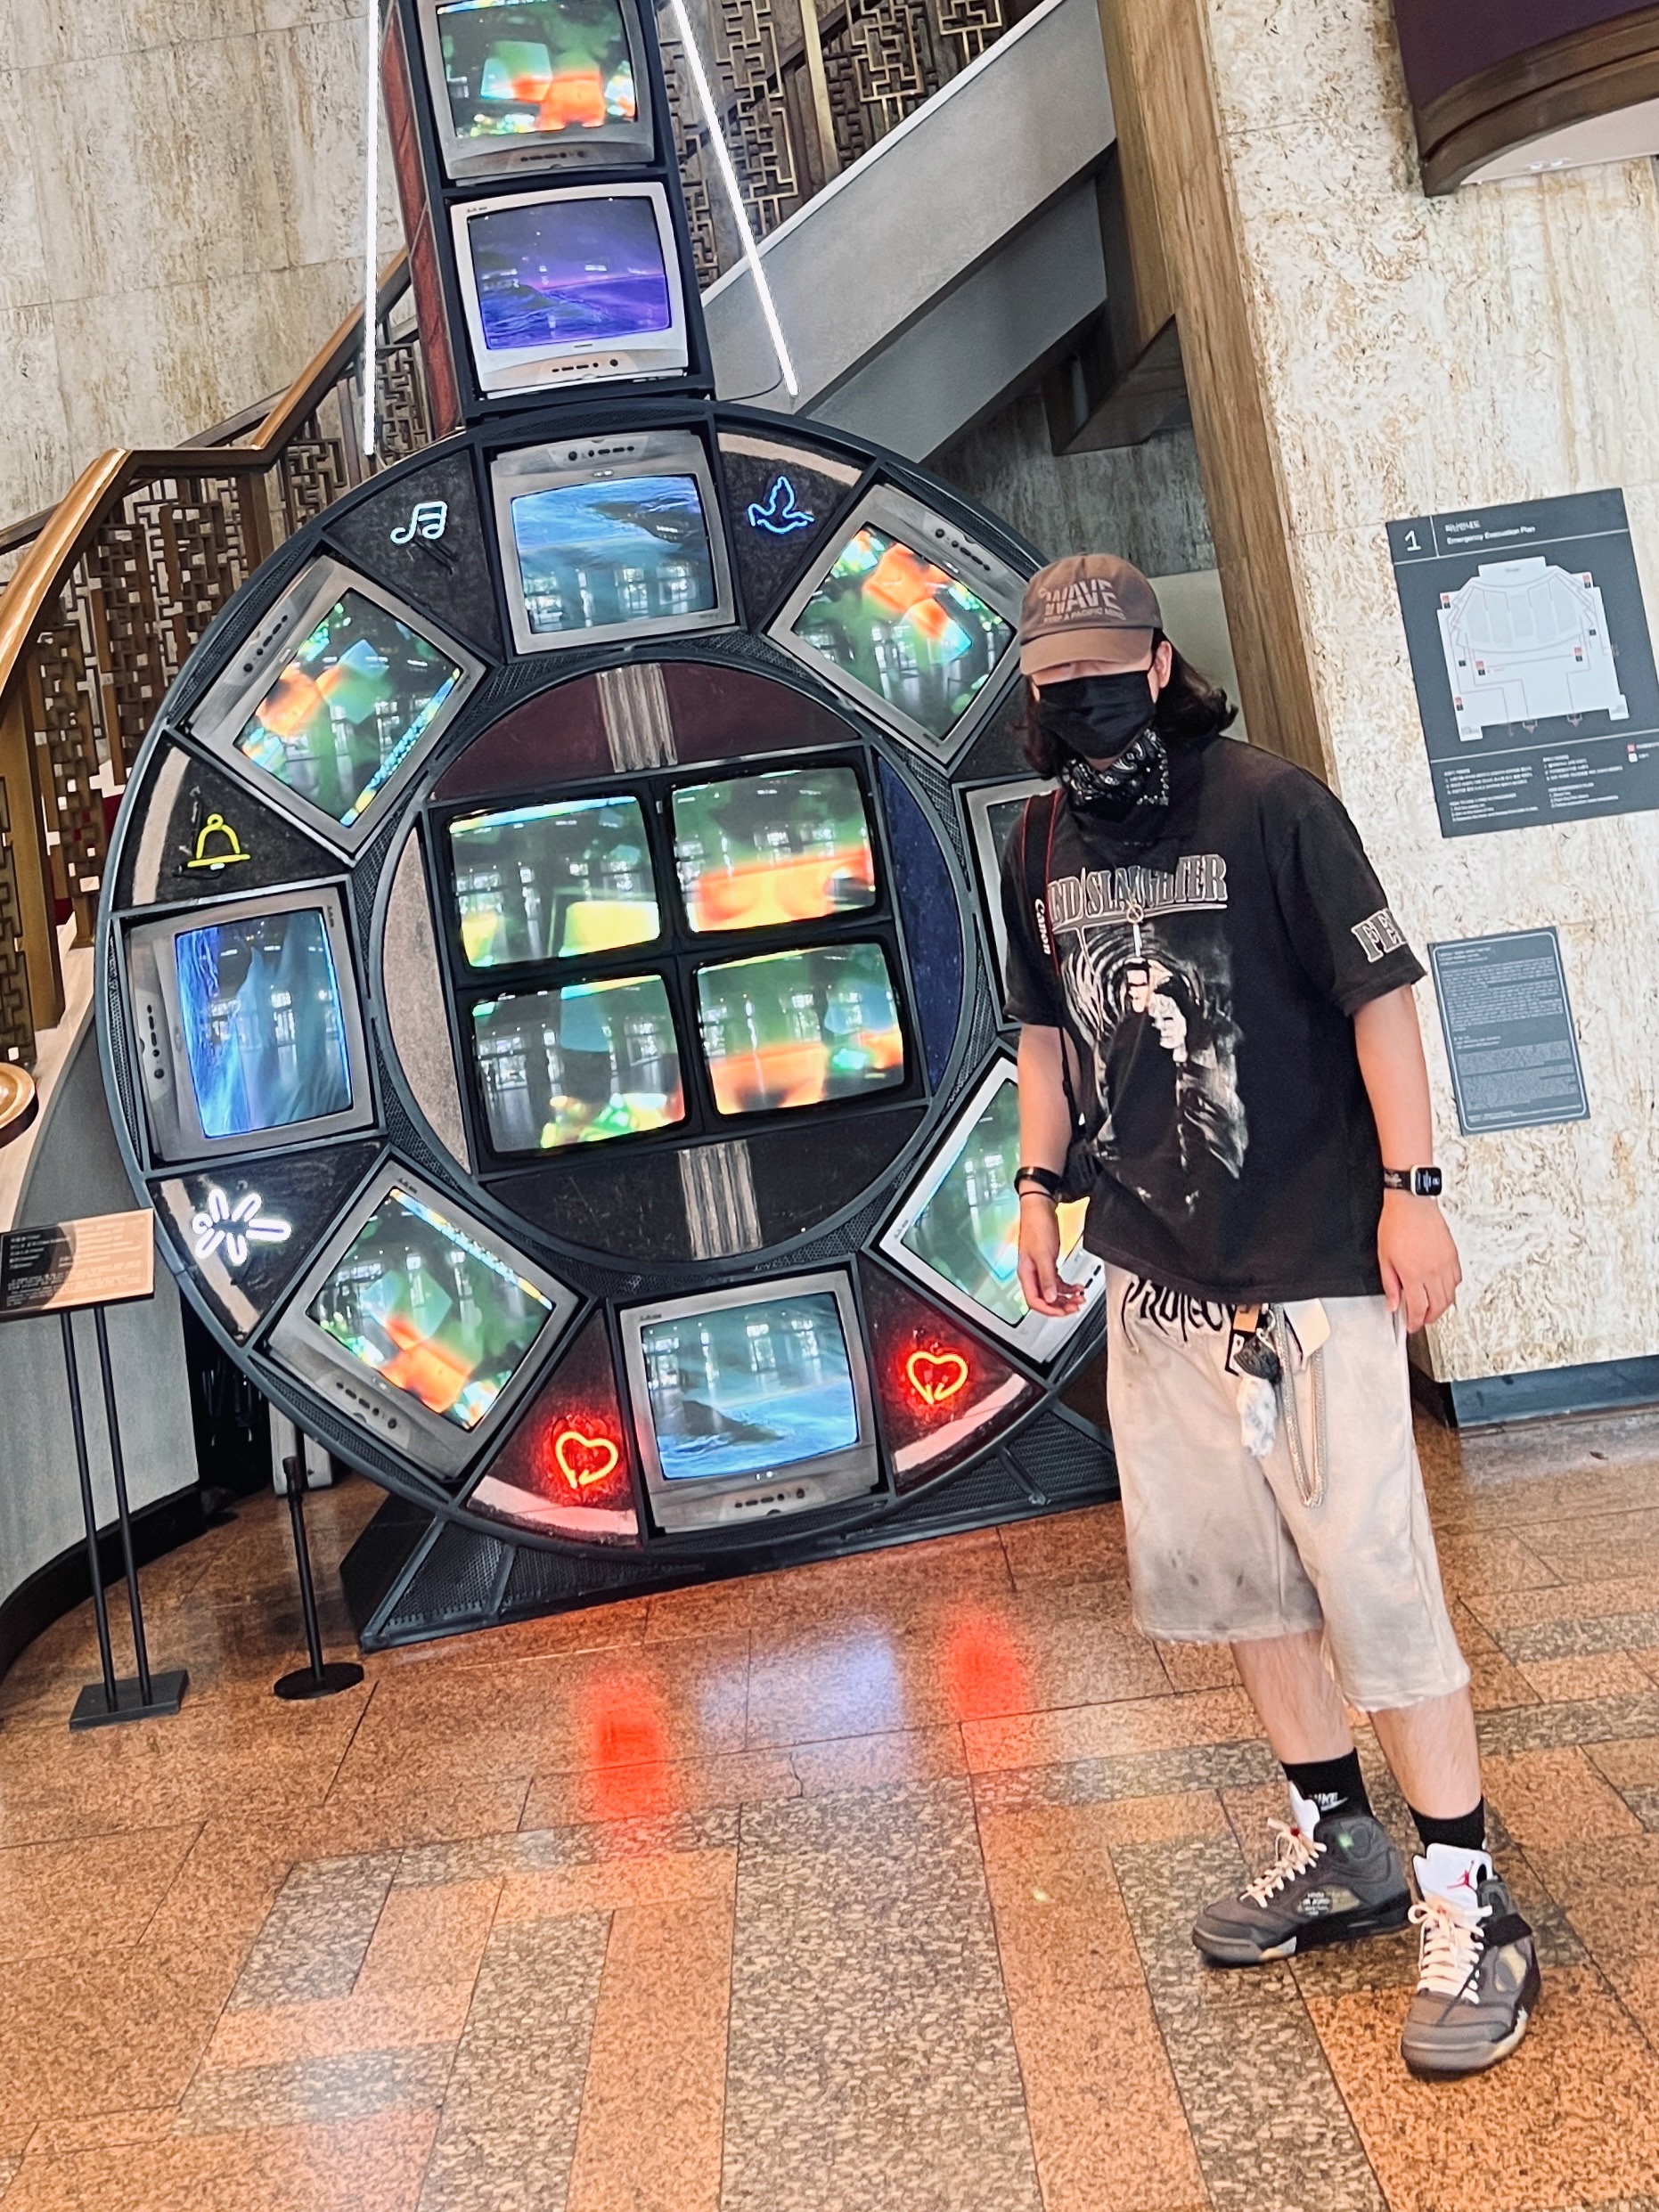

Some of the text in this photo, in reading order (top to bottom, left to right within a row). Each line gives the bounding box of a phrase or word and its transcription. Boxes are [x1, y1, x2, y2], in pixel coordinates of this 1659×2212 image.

[1404, 530, 1422, 551] 1
[1044, 578, 1124, 616] WAVE
[1086, 853, 1229, 918] SLAUGHTER
[1034, 898, 1051, 955] Canon
[1121, 1277, 1237, 1348] PROJEC
